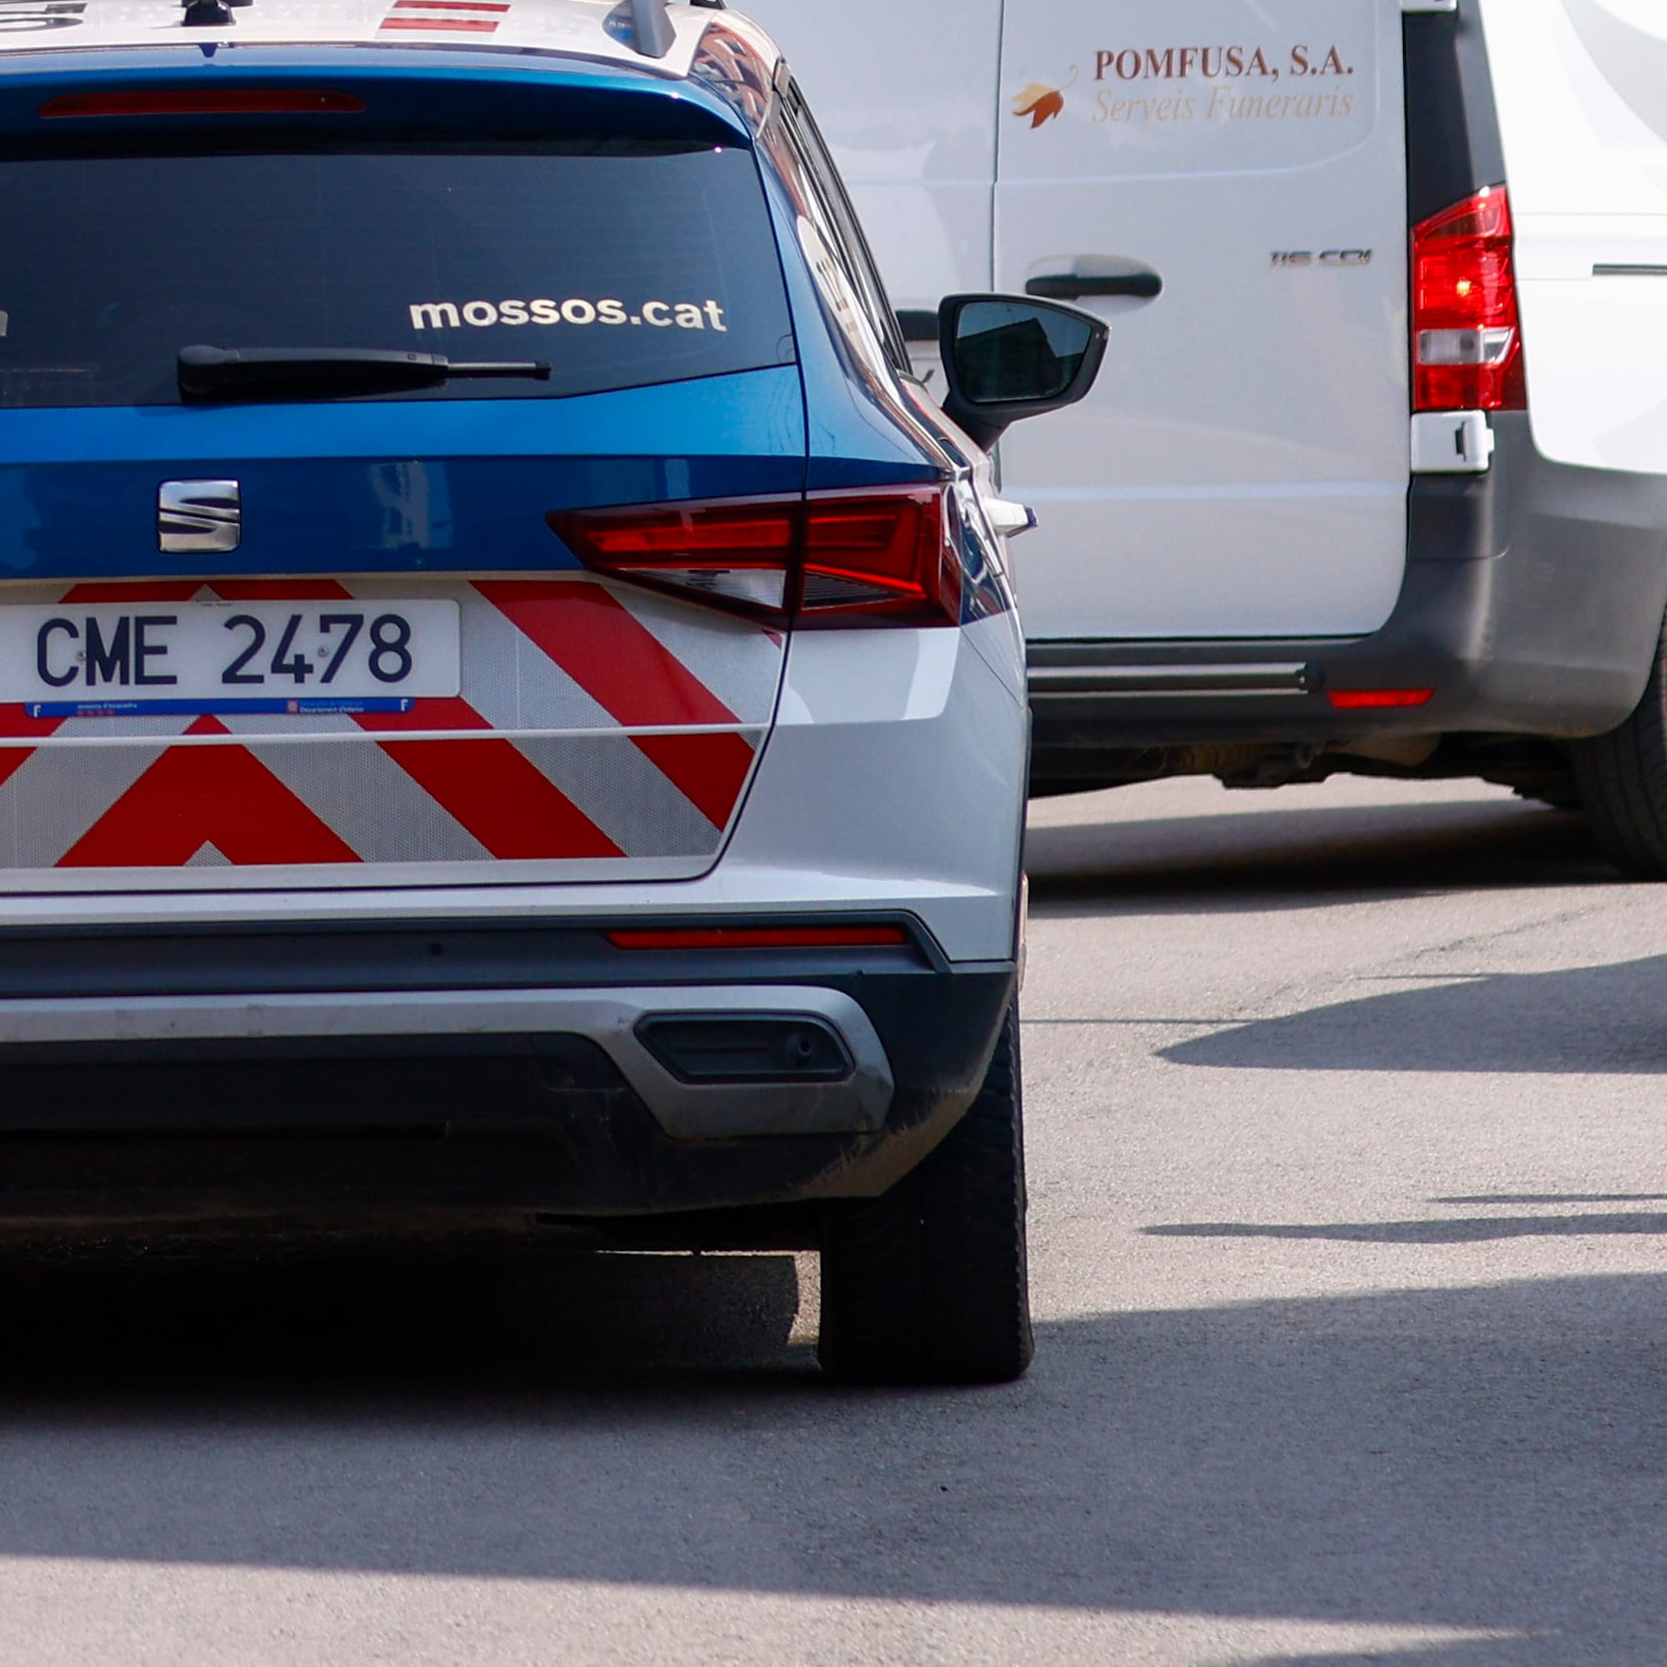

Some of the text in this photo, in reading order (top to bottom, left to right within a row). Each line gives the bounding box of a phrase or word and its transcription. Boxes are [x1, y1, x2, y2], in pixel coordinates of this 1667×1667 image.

[1094, 44, 1355, 82] POMFUSA, S.A.
[1092, 84, 1356, 126] Serveis Funeraris
[410, 294, 728, 333] mossos.cat
[36, 613, 414, 688] CME 2478
